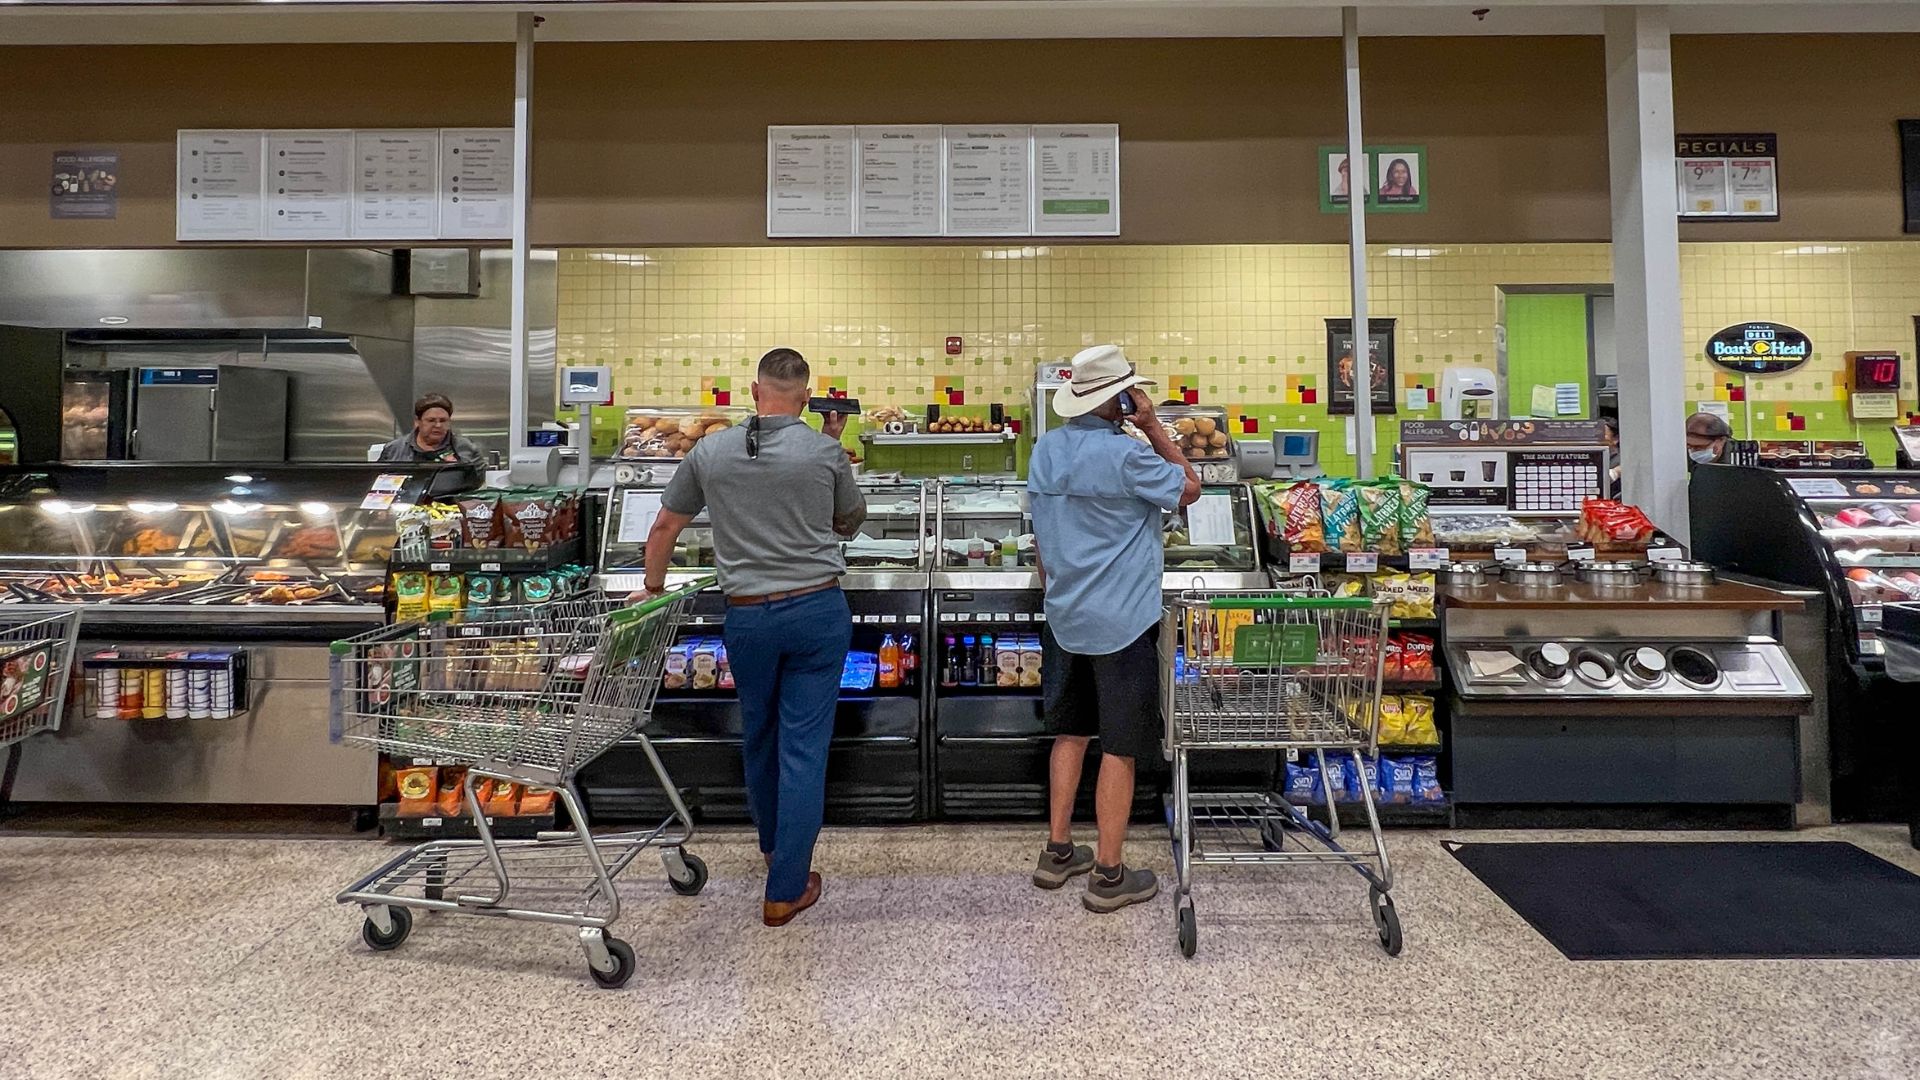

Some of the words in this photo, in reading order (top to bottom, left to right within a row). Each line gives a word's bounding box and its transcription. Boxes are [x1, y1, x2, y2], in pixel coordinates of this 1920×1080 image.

[1679, 142, 1767, 153] PECIALS
[1714, 341, 1752, 354] Boar's
[1771, 341, 1805, 354] Head
[1874, 363, 1895, 382] 10
[1394, 768, 1412, 781] Sun
[1293, 777, 1310, 788] Sun
